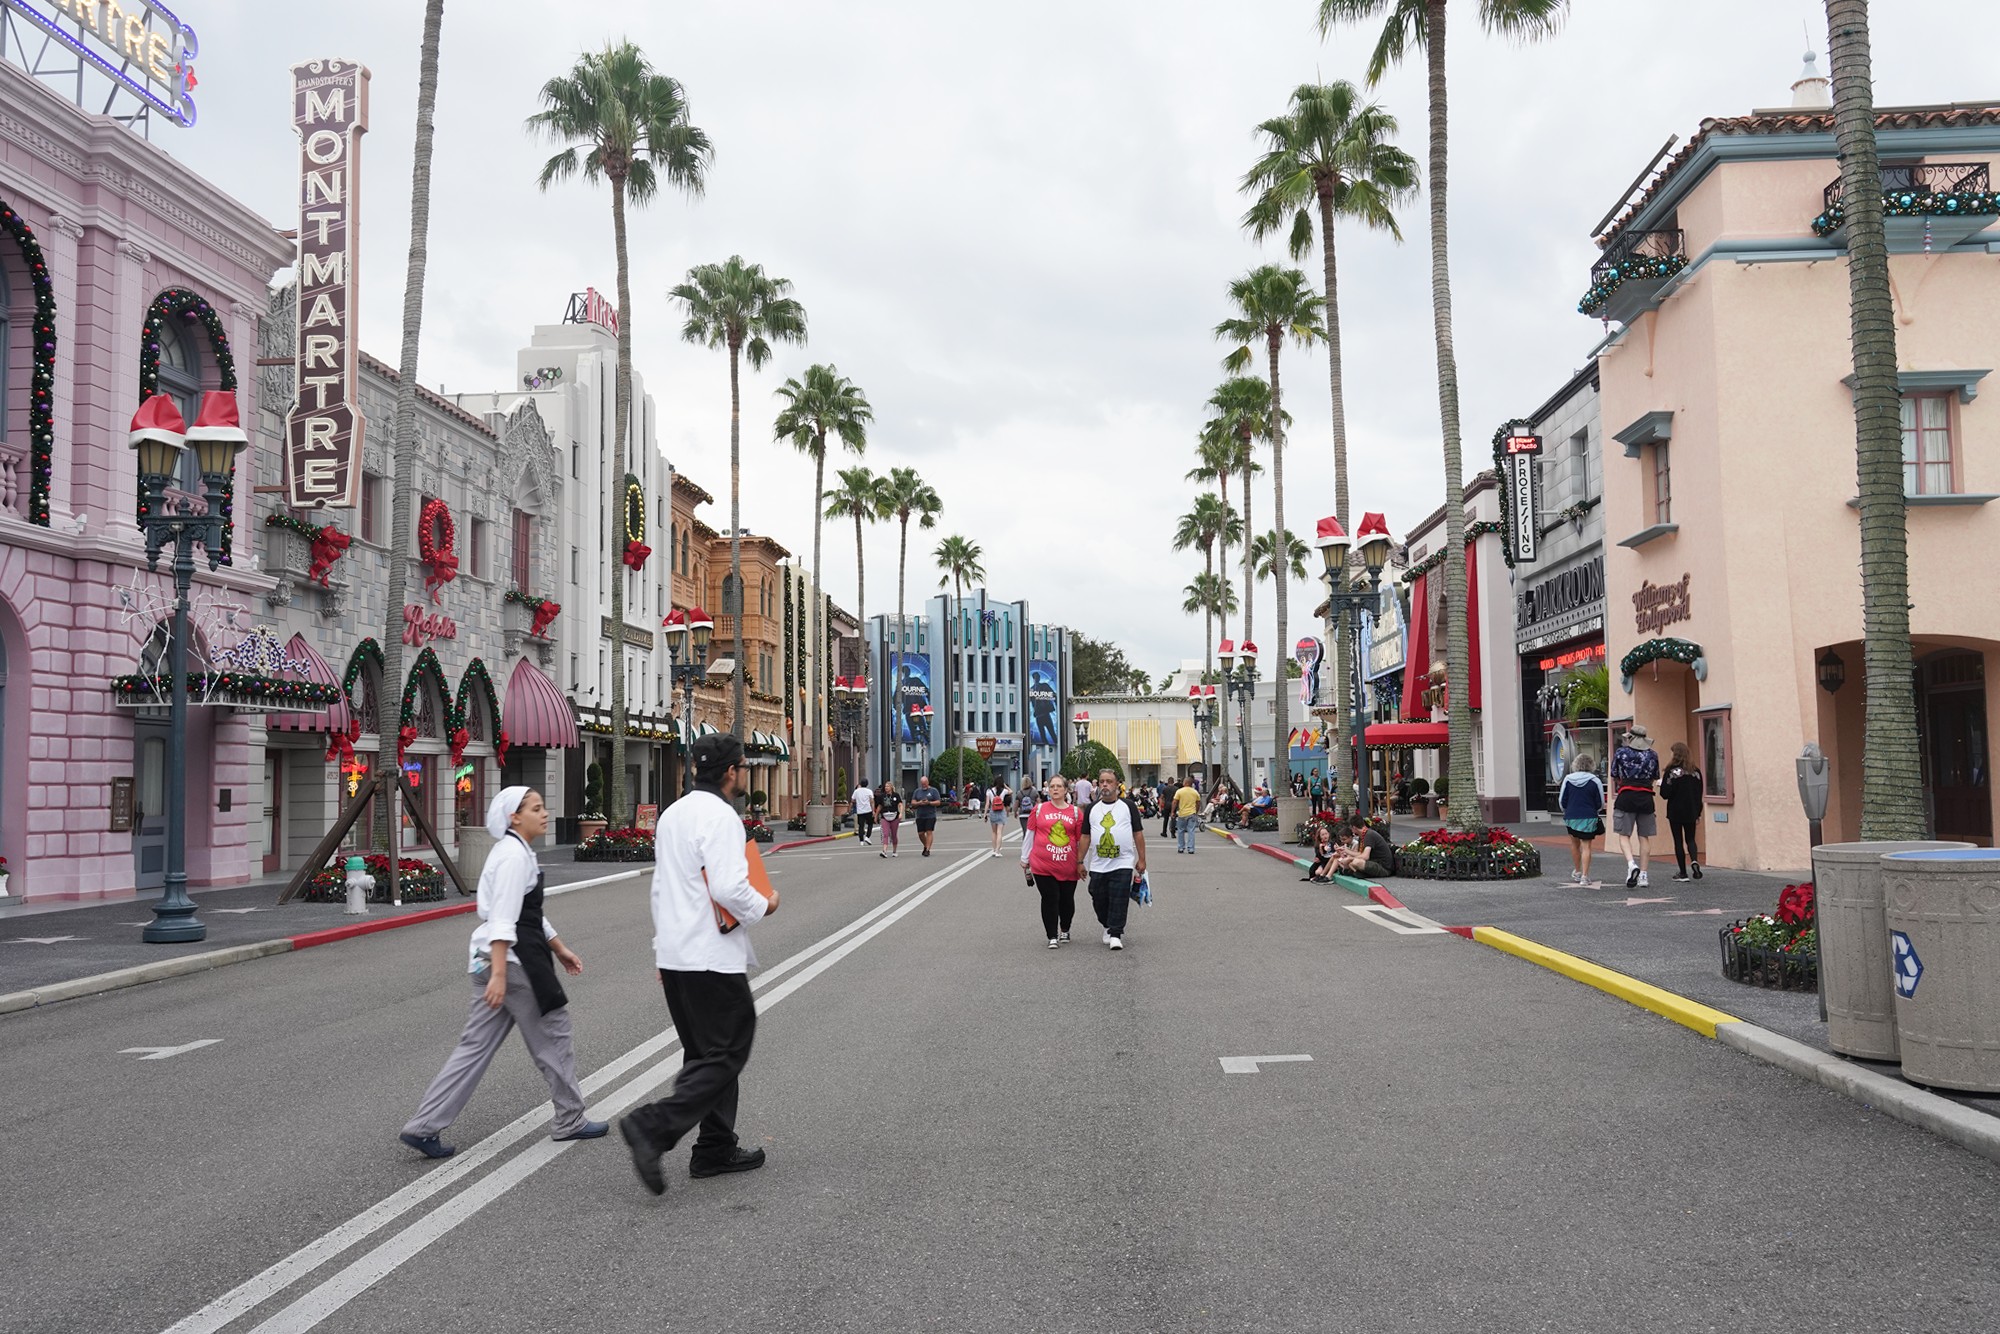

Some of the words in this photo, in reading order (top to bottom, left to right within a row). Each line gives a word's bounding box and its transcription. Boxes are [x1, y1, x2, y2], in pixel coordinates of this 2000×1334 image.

[303, 87, 346, 494] MONTMARTRE
[1507, 437, 1518, 453] 1
[1535, 555, 1605, 621] DARKROOM
[1632, 579, 1677, 613] Williams
[1635, 593, 1691, 636] Hollywood
[1045, 811, 1074, 825] RESTING
[1046, 843, 1072, 854] GRINCH
[1052, 853, 1067, 862] FACE
